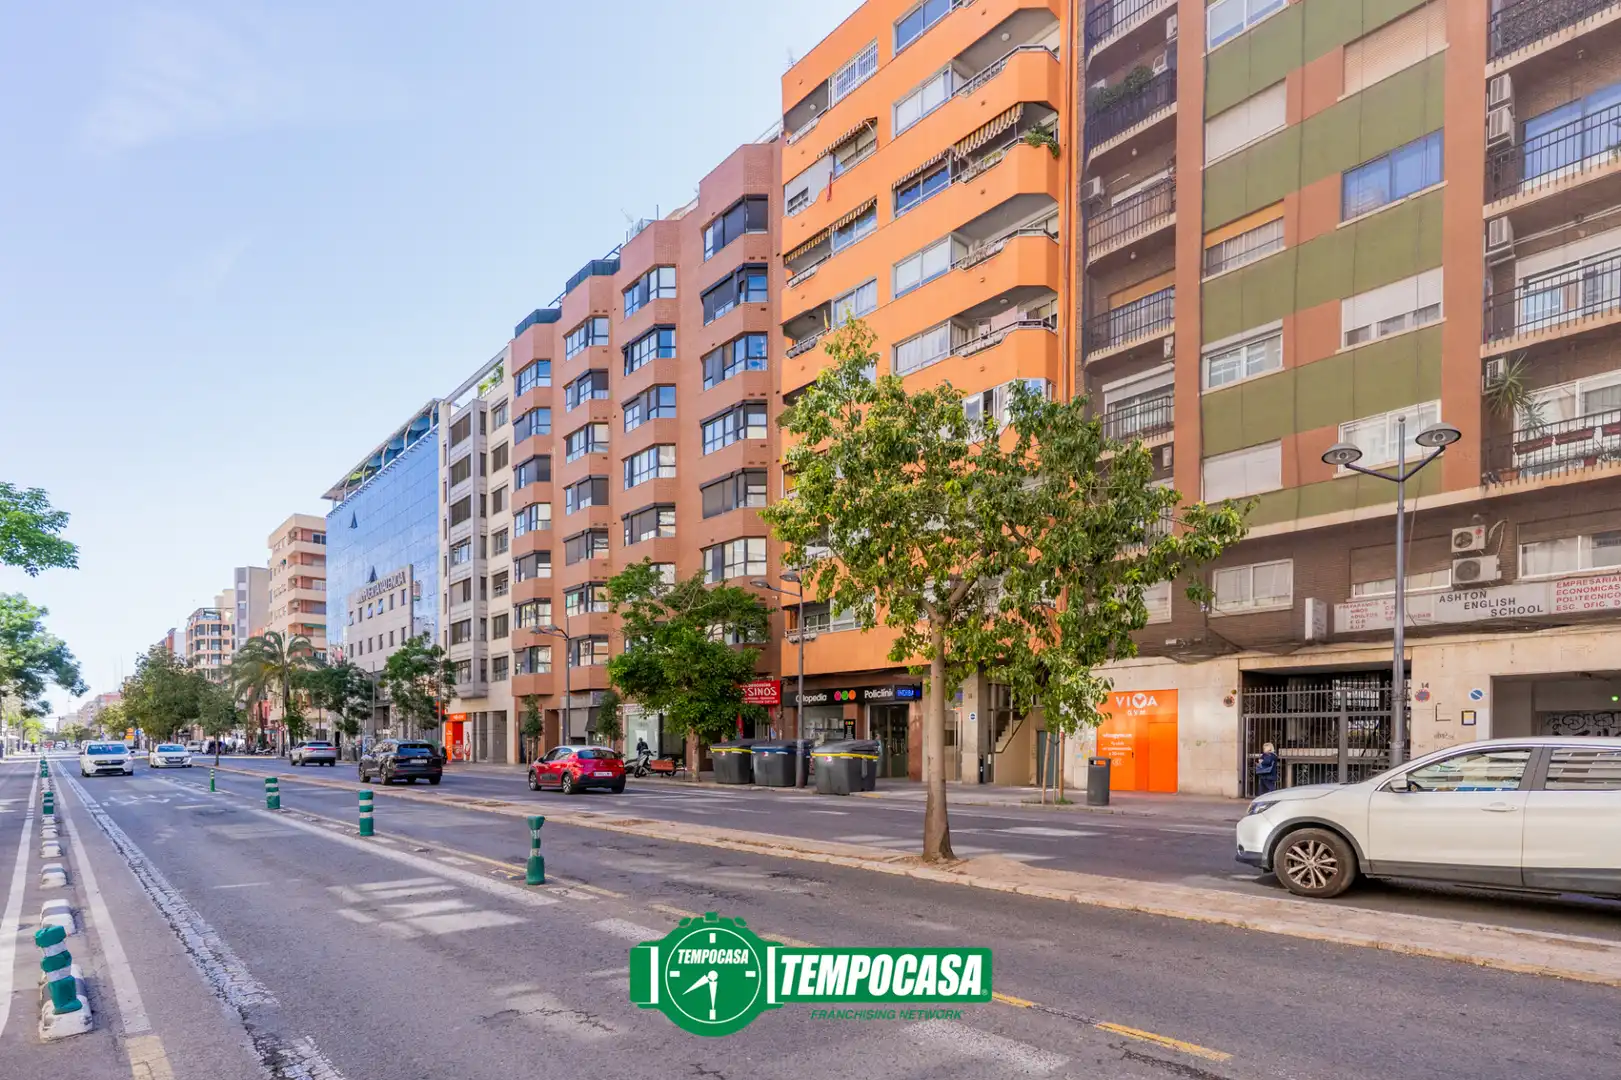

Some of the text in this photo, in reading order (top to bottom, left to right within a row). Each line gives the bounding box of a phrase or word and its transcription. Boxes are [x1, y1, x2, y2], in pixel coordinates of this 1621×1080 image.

[1556, 583, 1621, 596] ECONOMICAS
[1438, 590, 1487, 603] ASHTON
[1463, 597, 1516, 610] ENGLISH
[1490, 605, 1544, 617] SCHOOL
